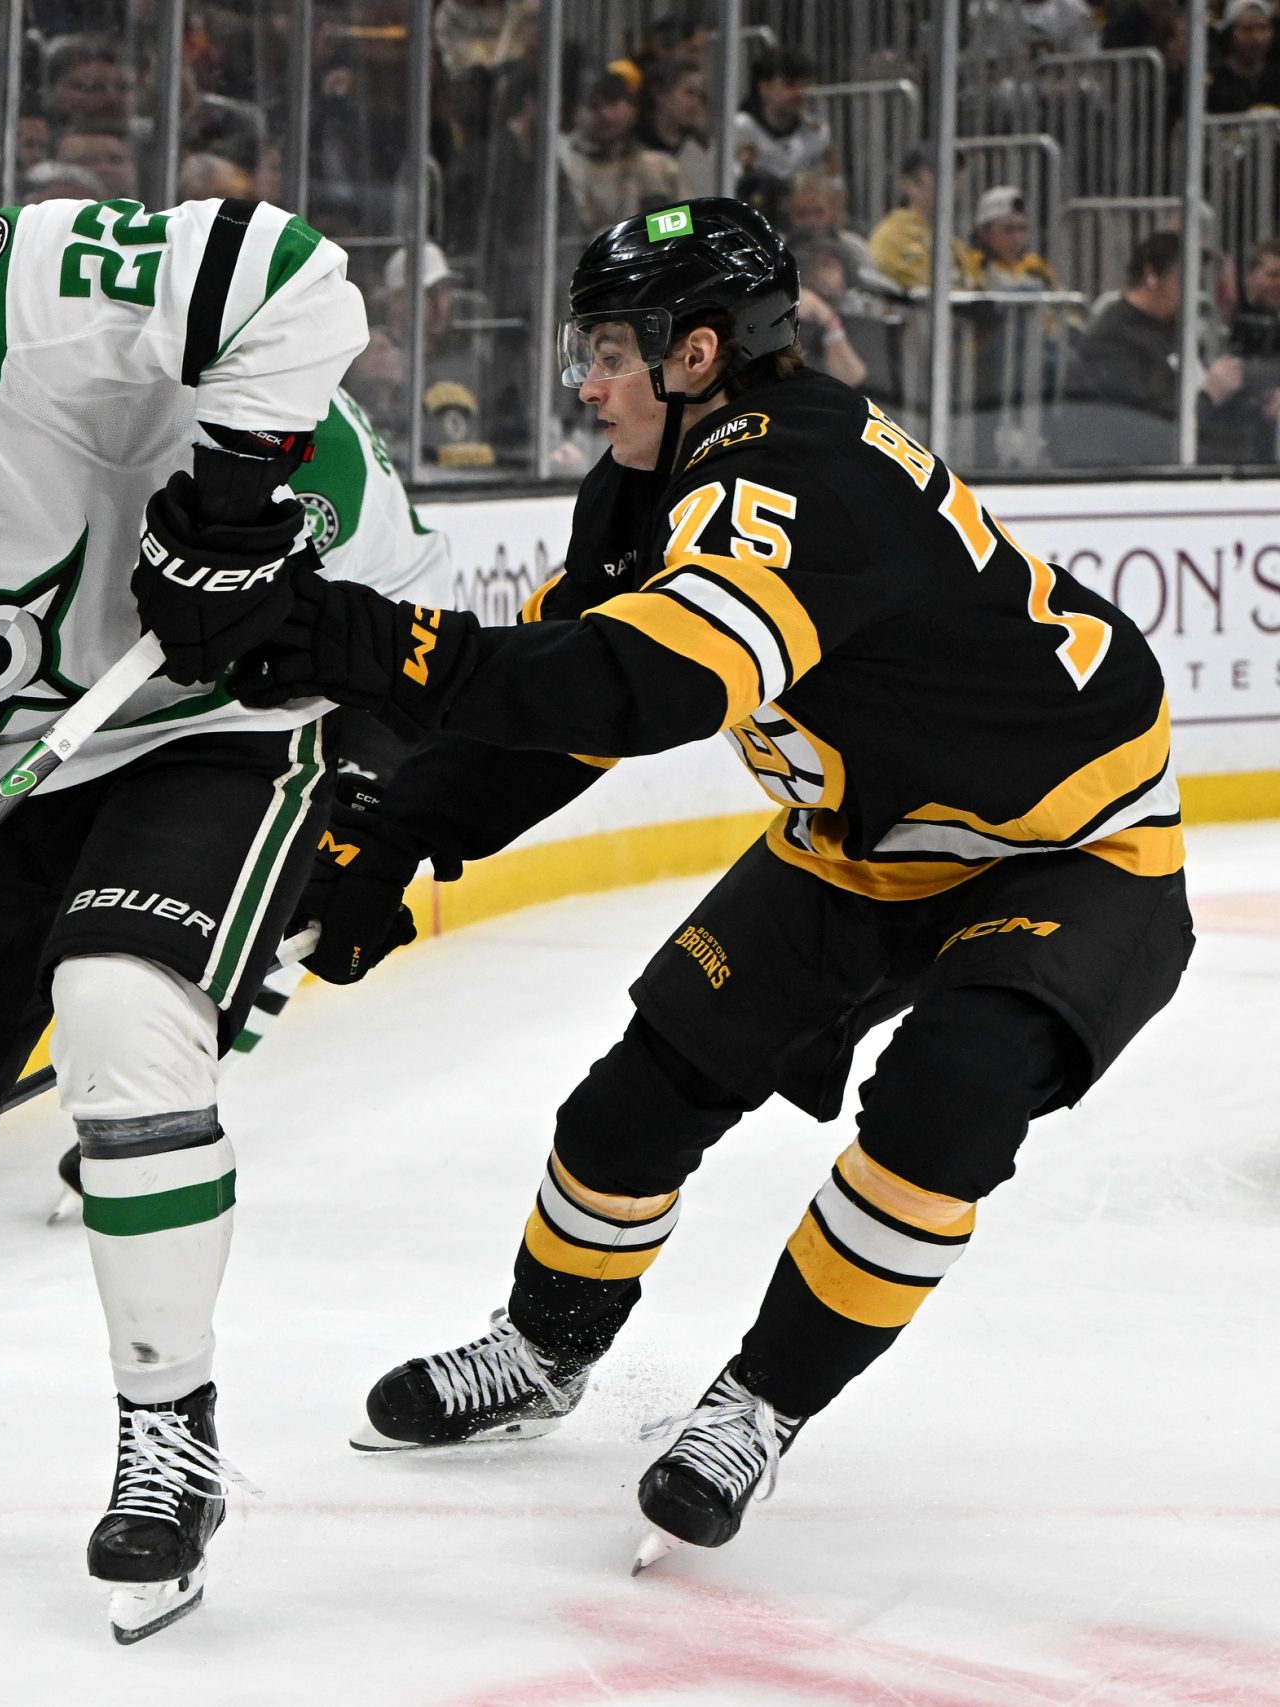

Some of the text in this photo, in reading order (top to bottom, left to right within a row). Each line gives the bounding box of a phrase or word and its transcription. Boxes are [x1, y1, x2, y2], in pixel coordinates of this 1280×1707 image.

[59, 199, 173, 307] 22
[650, 211, 688, 234] TD
[141, 532, 286, 592] AUER
[1051, 541, 1280, 639] ON'S
[402, 603, 442, 686] CM
[65, 887, 217, 938] BAUER
[674, 925, 732, 990] BRUINS
[697, 926, 728, 963] BOSTON
